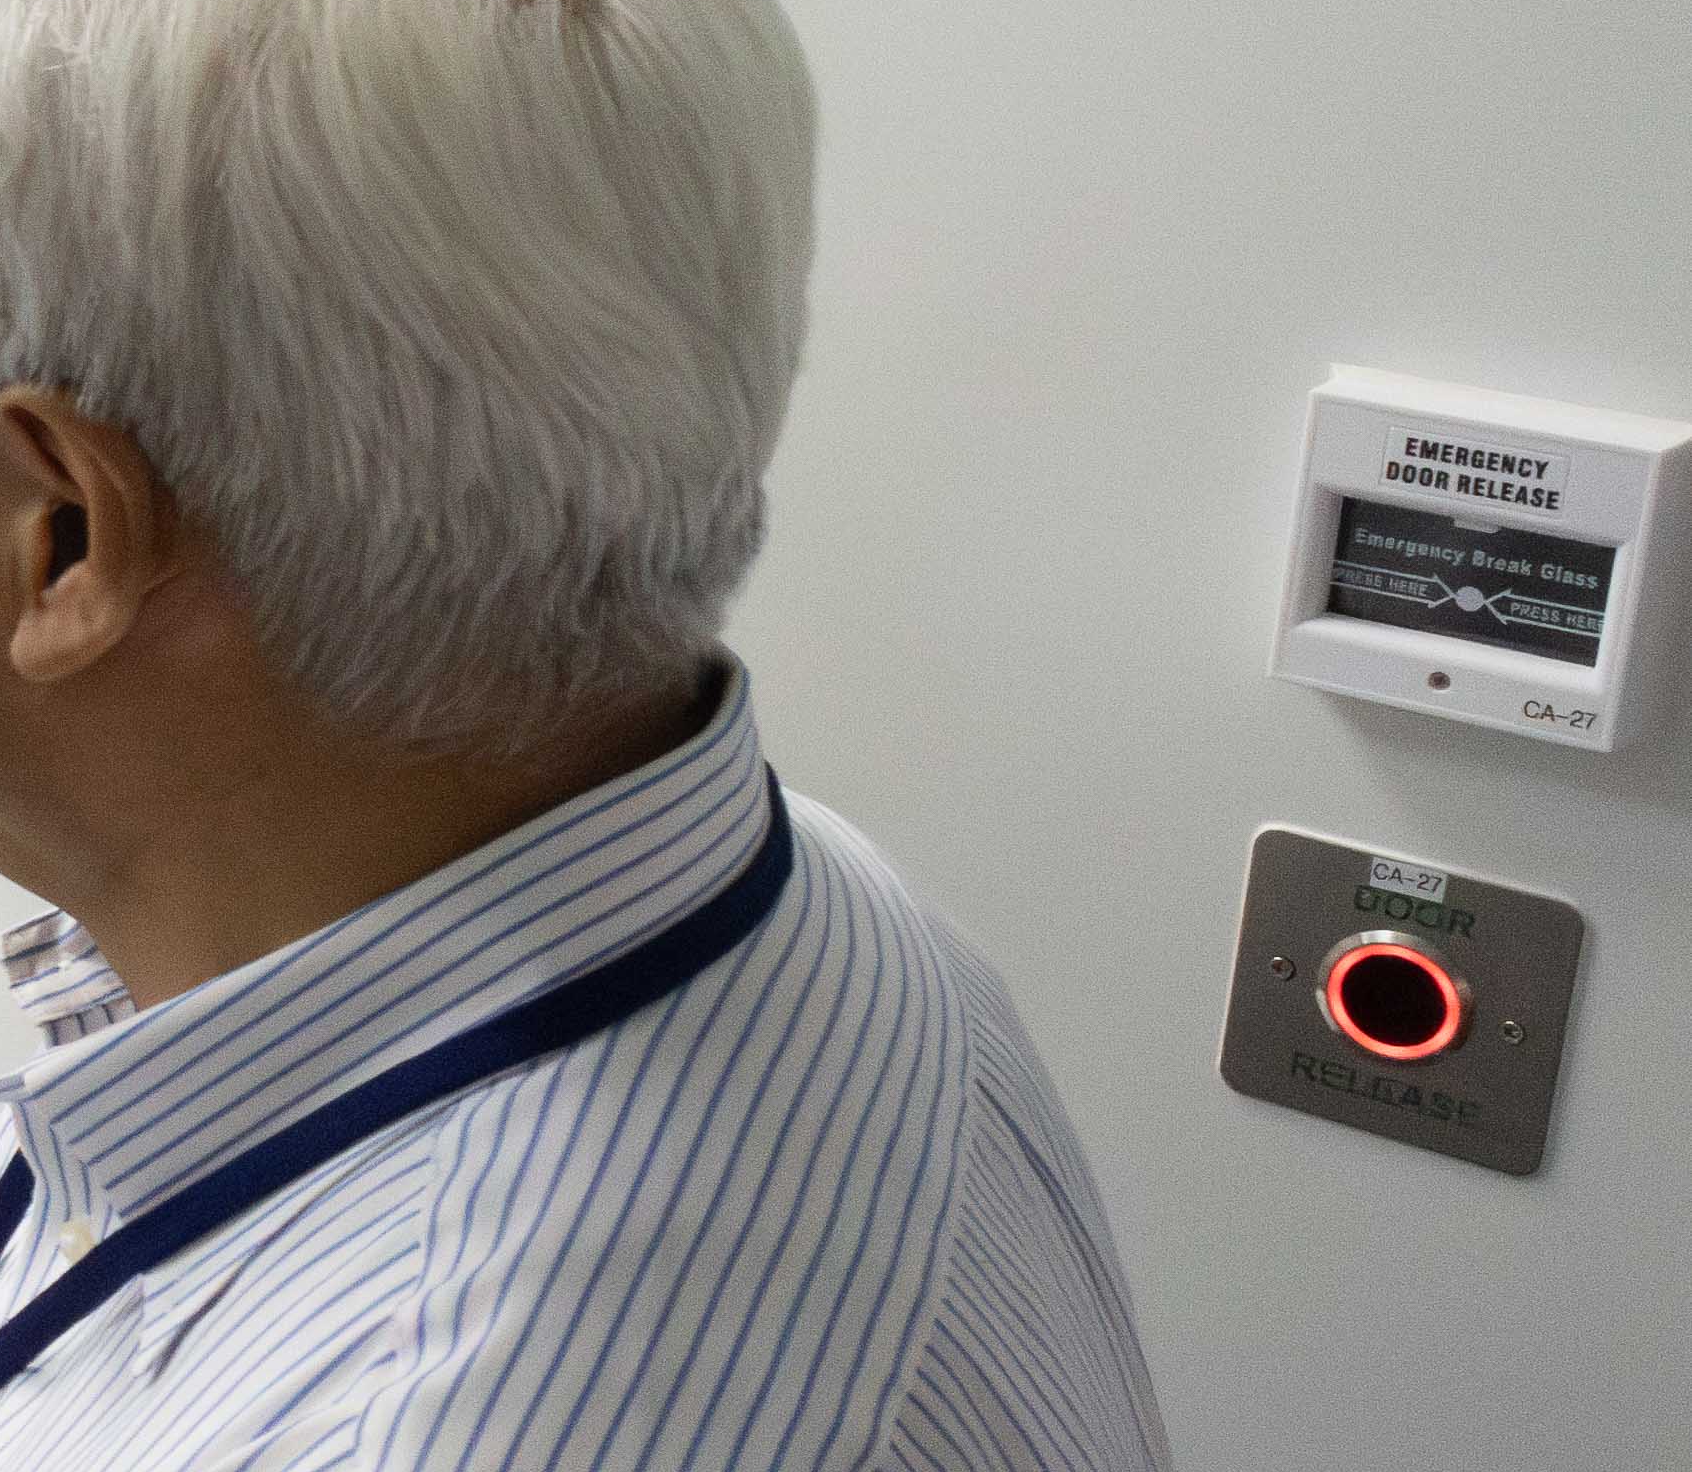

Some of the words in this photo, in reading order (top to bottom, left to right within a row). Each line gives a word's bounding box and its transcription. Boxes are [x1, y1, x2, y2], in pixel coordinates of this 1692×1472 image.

[1405, 436, 1549, 480] EMERGENCY
[1385, 461, 1450, 491] DOOR
[1456, 474, 1561, 510] RELEASE
[1354, 527, 1466, 566] Emergency
[1471, 548, 1533, 577] Break
[1540, 562, 1599, 590] Glass
[1509, 601, 1560, 623] PRESS
[1523, 700, 1597, 731] CA-27
[1373, 862, 1444, 894] CA-27
